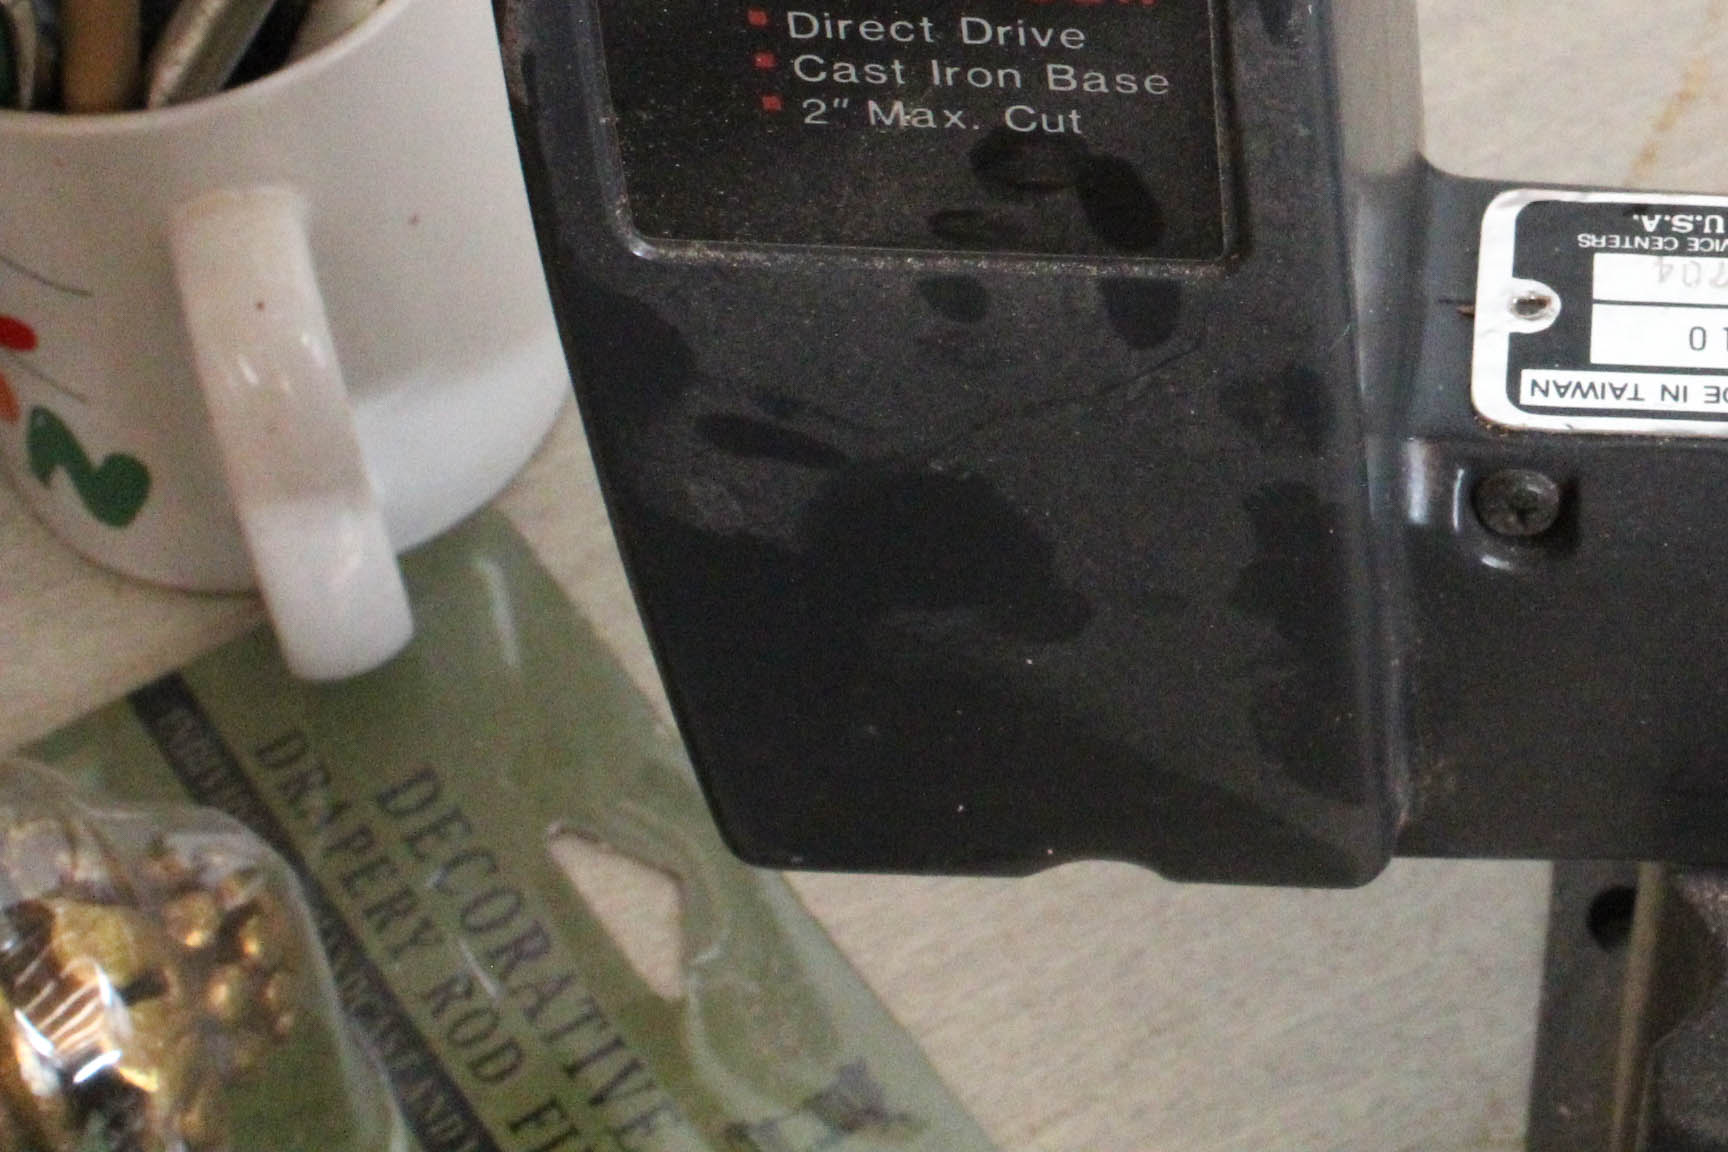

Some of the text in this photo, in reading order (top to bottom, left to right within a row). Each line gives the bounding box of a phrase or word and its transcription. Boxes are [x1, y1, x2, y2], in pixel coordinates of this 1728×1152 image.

[786, 11, 1086, 50] Direct Drive
[792, 54, 1171, 96] Cast Iron Base
[802, 97, 1083, 136] 2" Max. Cut
[1576, 232, 1679, 252] CENTERS
[1530, 378, 1646, 403] TAIWAN
[1660, 383, 1688, 405] IN
[253, 727, 443, 965] DRAPERY
[424, 974, 527, 1088] ROD
[376, 765, 686, 1150] DECORATIVE
